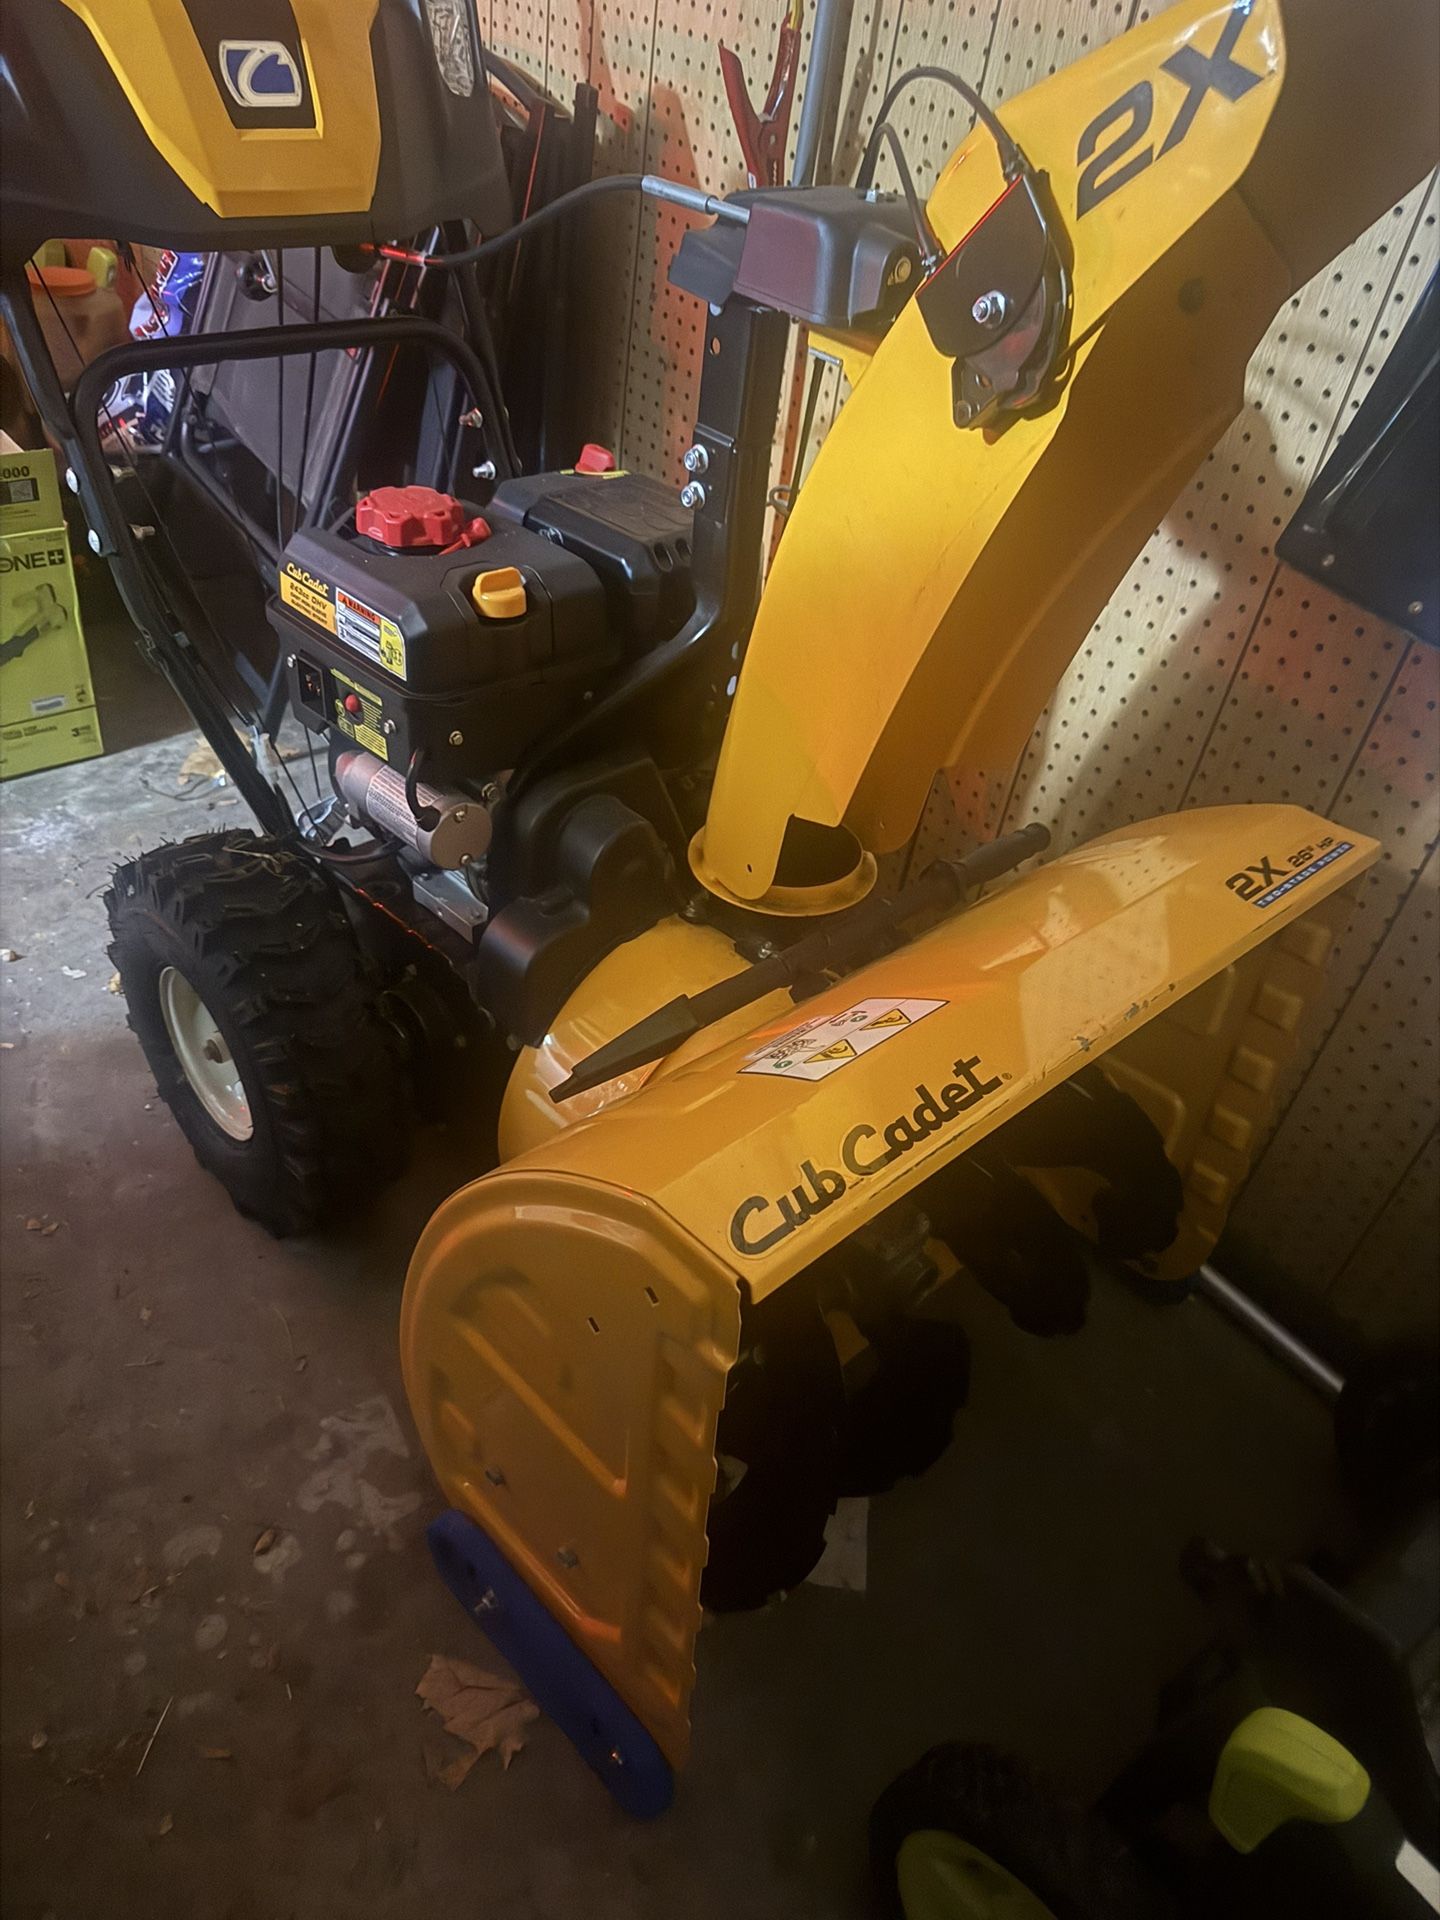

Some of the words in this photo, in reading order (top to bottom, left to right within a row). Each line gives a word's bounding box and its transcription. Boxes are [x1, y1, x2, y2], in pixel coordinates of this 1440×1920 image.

[1077, 0, 1263, 221] 2X
[286, 562, 302, 580] Cub
[302, 571, 329, 595] Cadet
[1225, 856, 1291, 901] 2X
[730, 1160, 847, 1255] Cub
[842, 1055, 1003, 1176] Cadet
